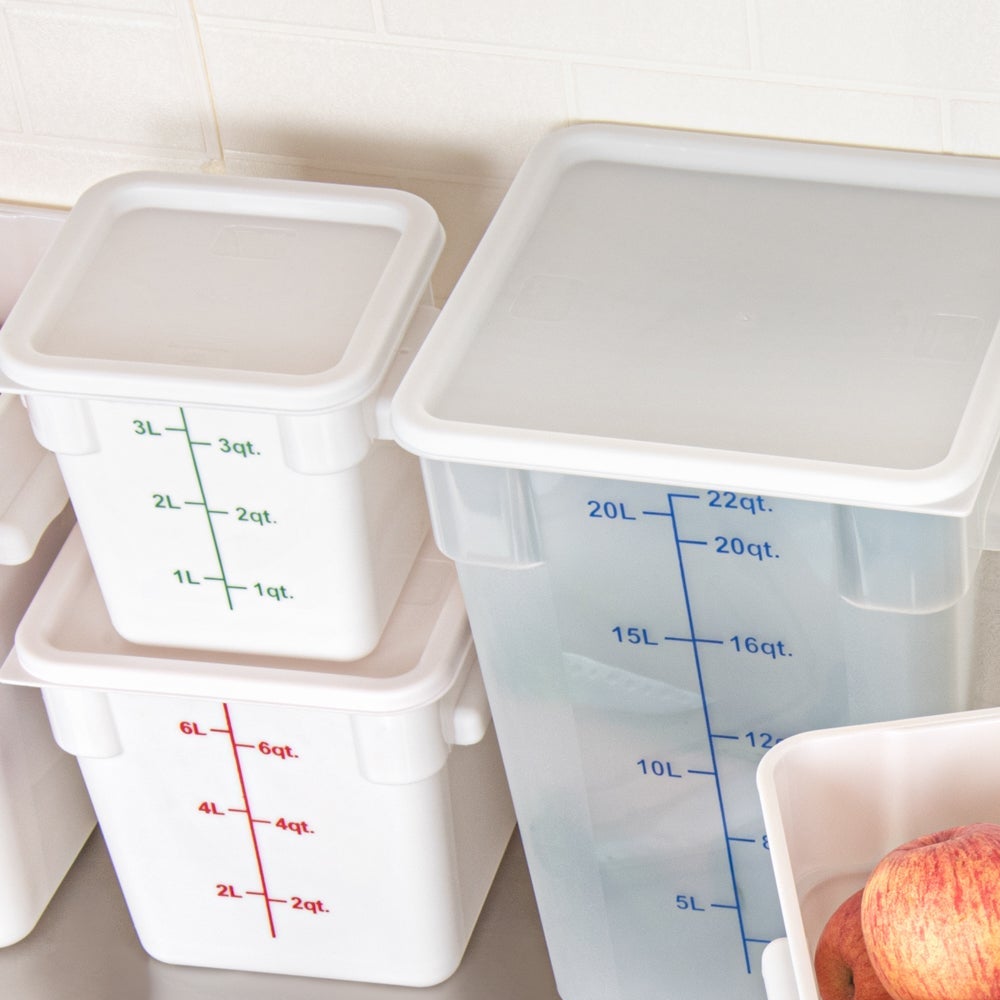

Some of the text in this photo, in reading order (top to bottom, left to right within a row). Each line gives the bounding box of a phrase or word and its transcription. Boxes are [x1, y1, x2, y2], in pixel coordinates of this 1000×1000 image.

[132, 419, 162, 436] 3L
[218, 437, 261, 458] 3qt.
[152, 493, 181, 510] 2L
[587, 500, 637, 521] 20L
[706, 489, 774, 516] 22qt.
[235, 506, 277, 527] 2qt.
[714, 535, 780, 561] 20qt.
[173, 569, 201, 585] 1L
[253, 582, 294, 602] 1qt.
[612, 626, 659, 646] 15L
[729, 635, 793, 660] 16qt.
[179, 721, 207, 736] 6L
[745, 731, 784, 749] 12
[257, 741, 299, 760] 6qt.
[636, 759, 682, 778] 10L
[197, 801, 225, 816] 4L
[274, 817, 315, 836] 4qt.
[215, 883, 243, 899] 2L
[290, 896, 330, 915] 2qt.
[675, 894, 705, 912] 5L
